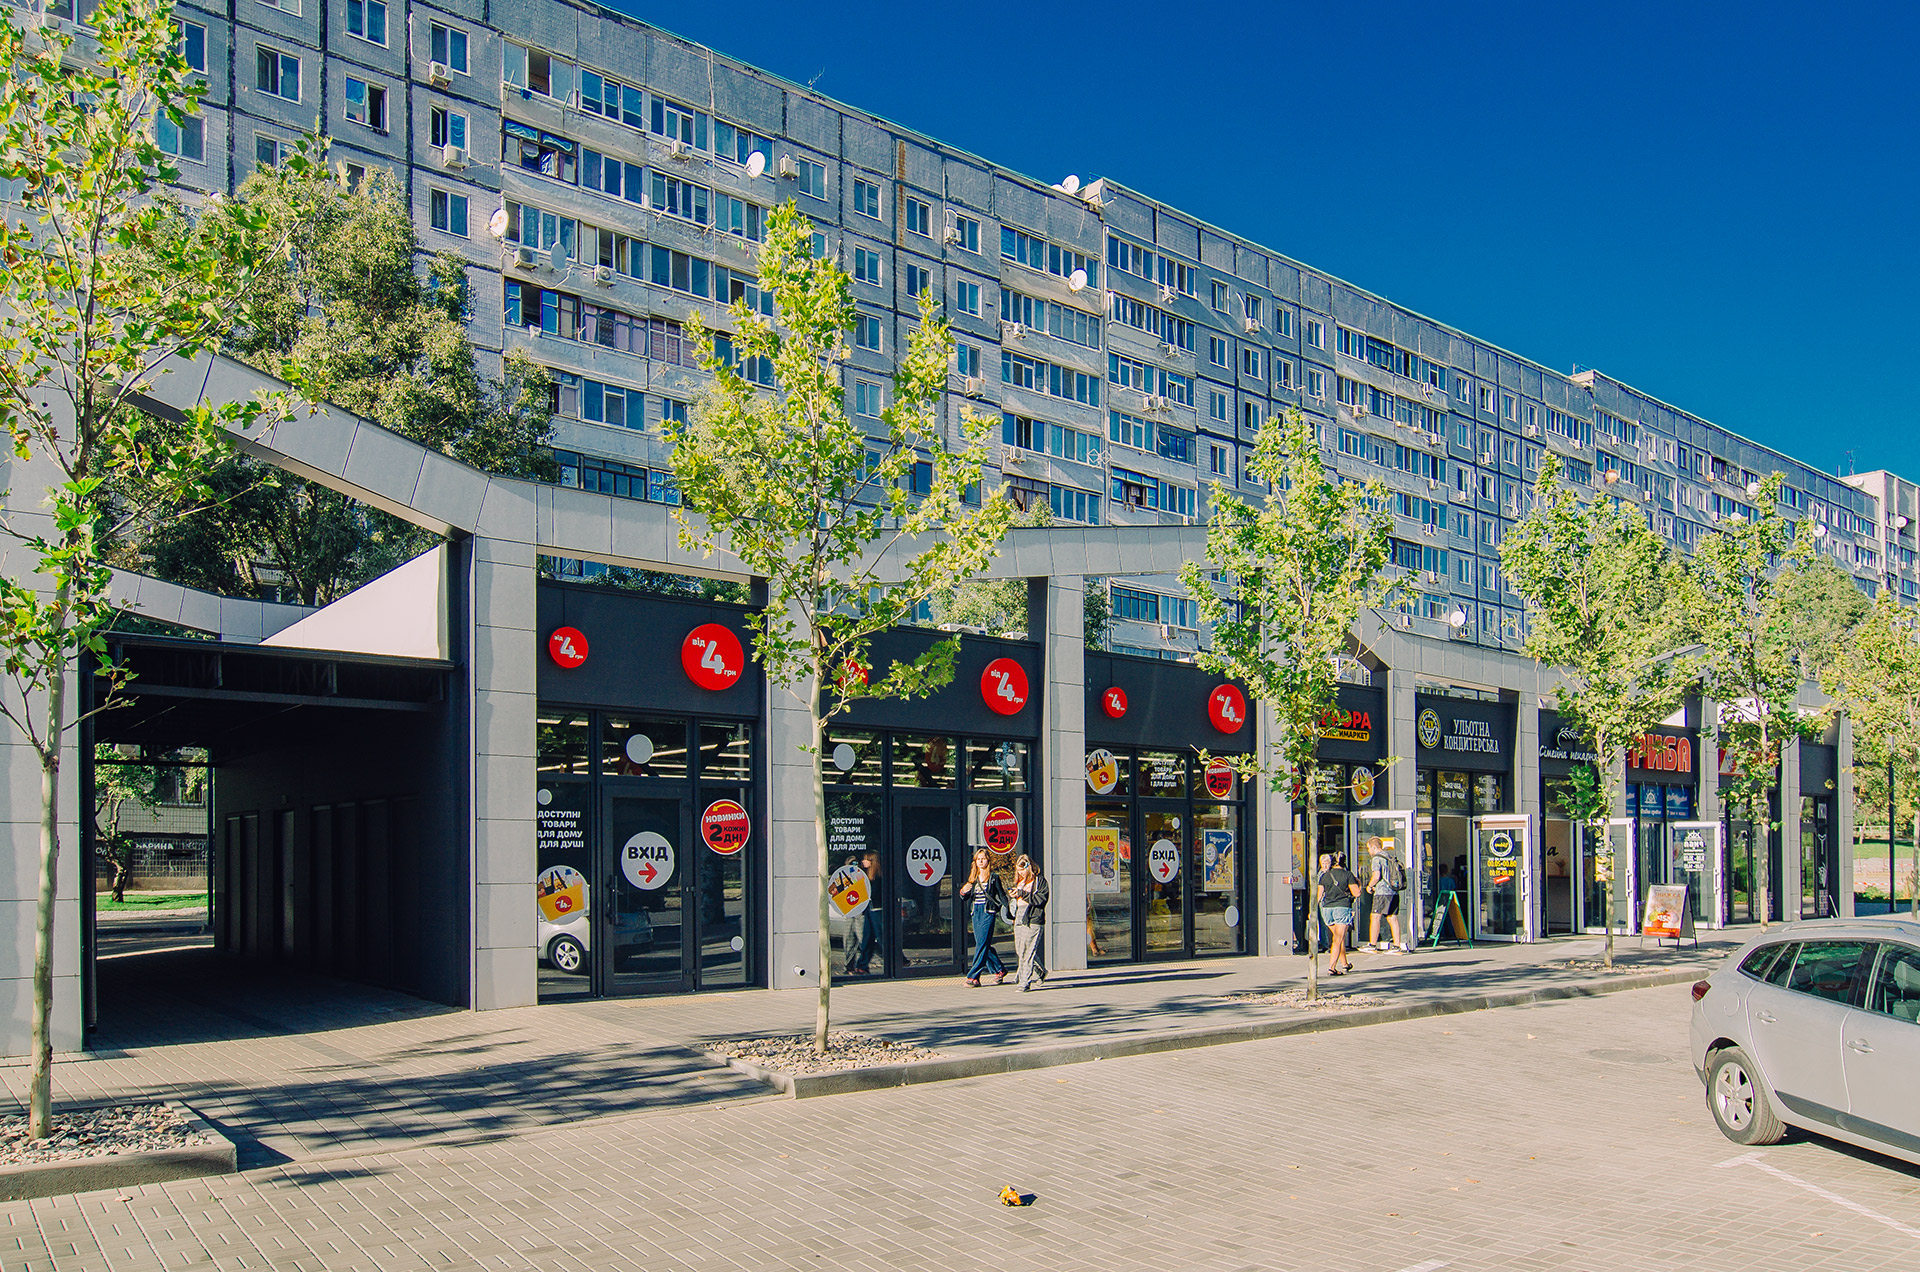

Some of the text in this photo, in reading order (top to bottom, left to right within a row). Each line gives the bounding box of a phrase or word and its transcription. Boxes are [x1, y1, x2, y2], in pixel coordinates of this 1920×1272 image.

[560, 636, 576, 658] 4
[692, 637, 706, 648] від
[701, 640, 725, 675] 4
[723, 669, 737, 678] грн
[991, 669, 1001, 679] від
[997, 672, 1015, 702] 4
[1111, 694, 1121, 711] 4
[1222, 695, 1236, 722] 4
[1453, 719, 1491, 737] УЛЬОТНА
[1443, 734, 1500, 754] КОНДИТЕРСЬКА
[1539, 744, 1569, 760] Сімейна
[1632, 732, 1692, 773] РИБА
[1209, 775, 1218, 789] 2
[537, 810, 581, 819] ДОСТУПНІ
[705, 812, 745, 824] НОВИНКИ
[541, 820, 577, 829] ТОВАРИ
[986, 818, 1016, 827] НОВИНКИ
[556, 830, 583, 839] ДОМУ
[709, 824, 723, 842] 2
[723, 834, 743, 843] ДНІ
[830, 835, 845, 843] ДЛЯ
[988, 828, 999, 843] 2
[1089, 834, 1111, 843] АКЦІЯ
[539, 840, 584, 849] ДЛЯ ДУШІ
[999, 836, 1014, 845] ДНІ
[627, 846, 669, 862] ВХІД
[911, 849, 942, 862] ВХІД
[1152, 850, 1176, 862] ВХІД
